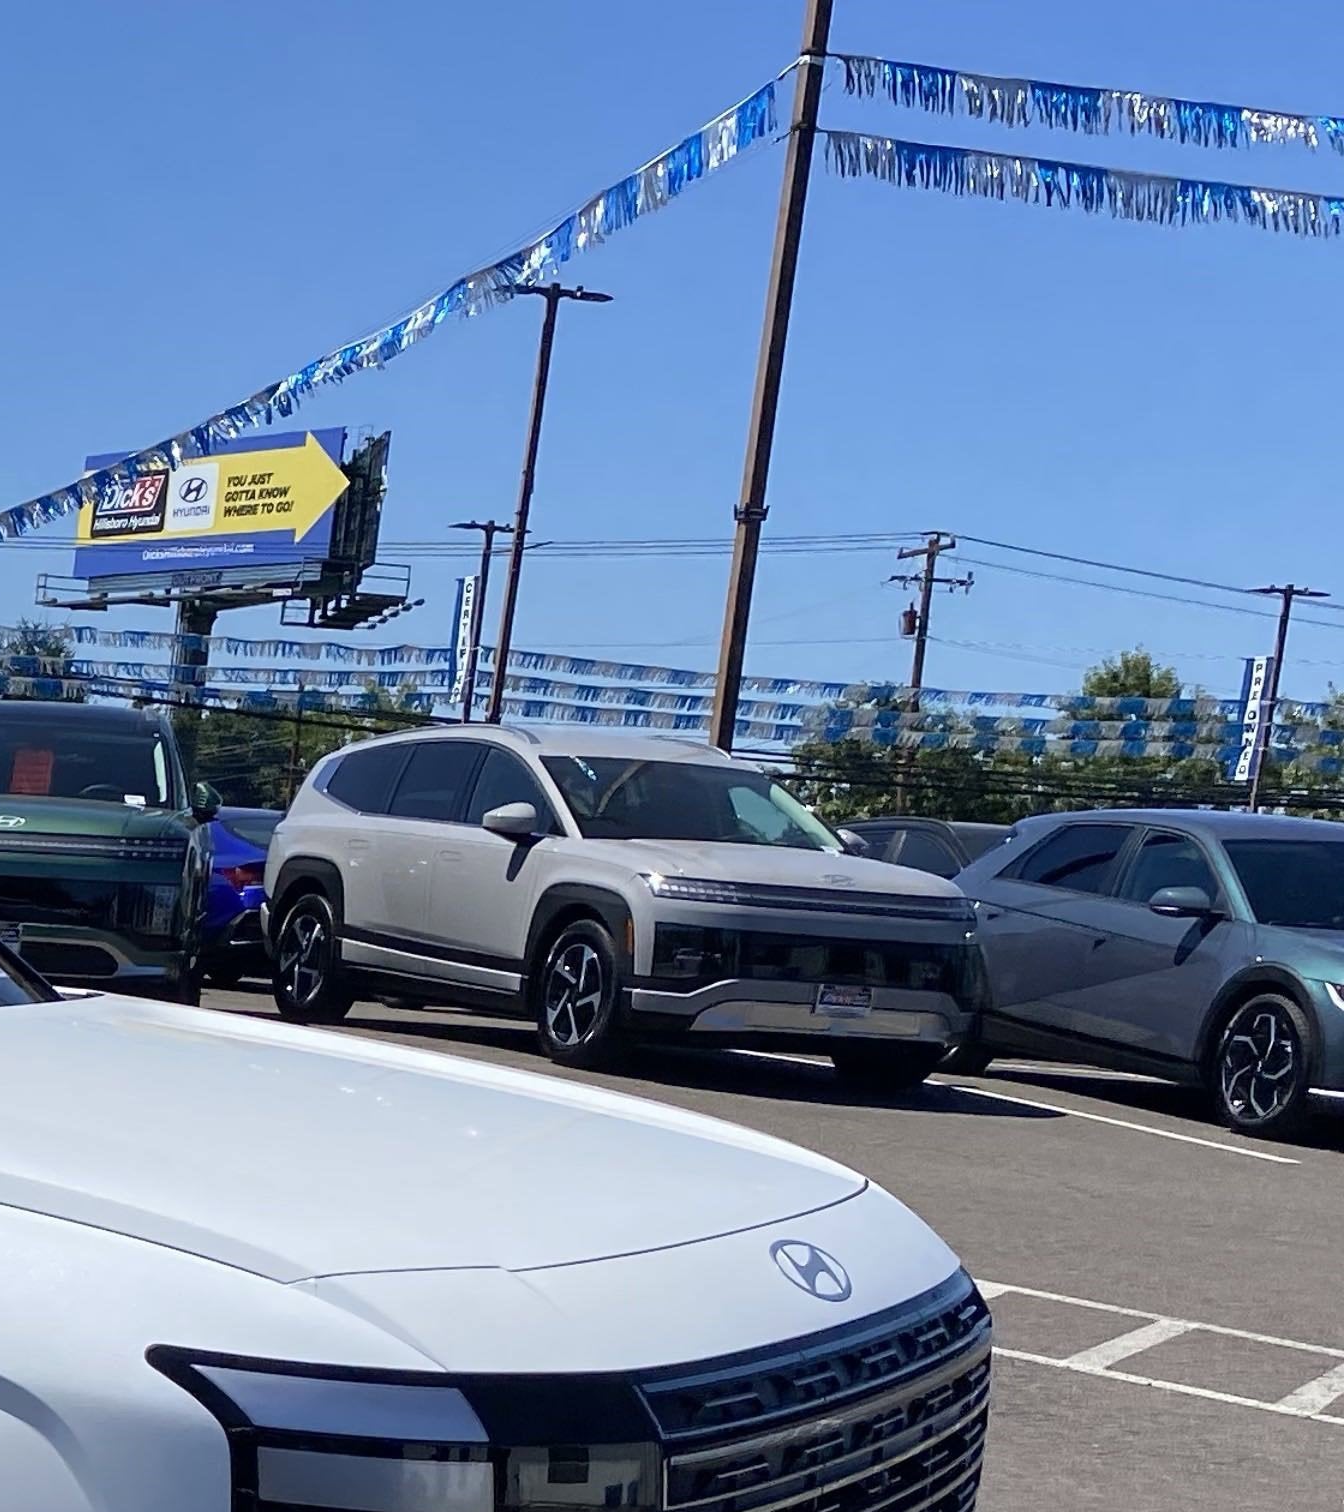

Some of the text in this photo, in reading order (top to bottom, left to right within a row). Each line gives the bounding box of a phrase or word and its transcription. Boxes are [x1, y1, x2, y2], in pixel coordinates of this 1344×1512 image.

[227, 473, 273, 487] YOU JUST
[224, 487, 289, 502] GOTTA KNOW
[172, 506, 210, 518] HYUNDAI
[223, 501, 295, 517] WHERE TO GO!
[93, 513, 161, 531] Hillsboro Hyundai
[1238, 663, 1264, 775] PRE OWNED
